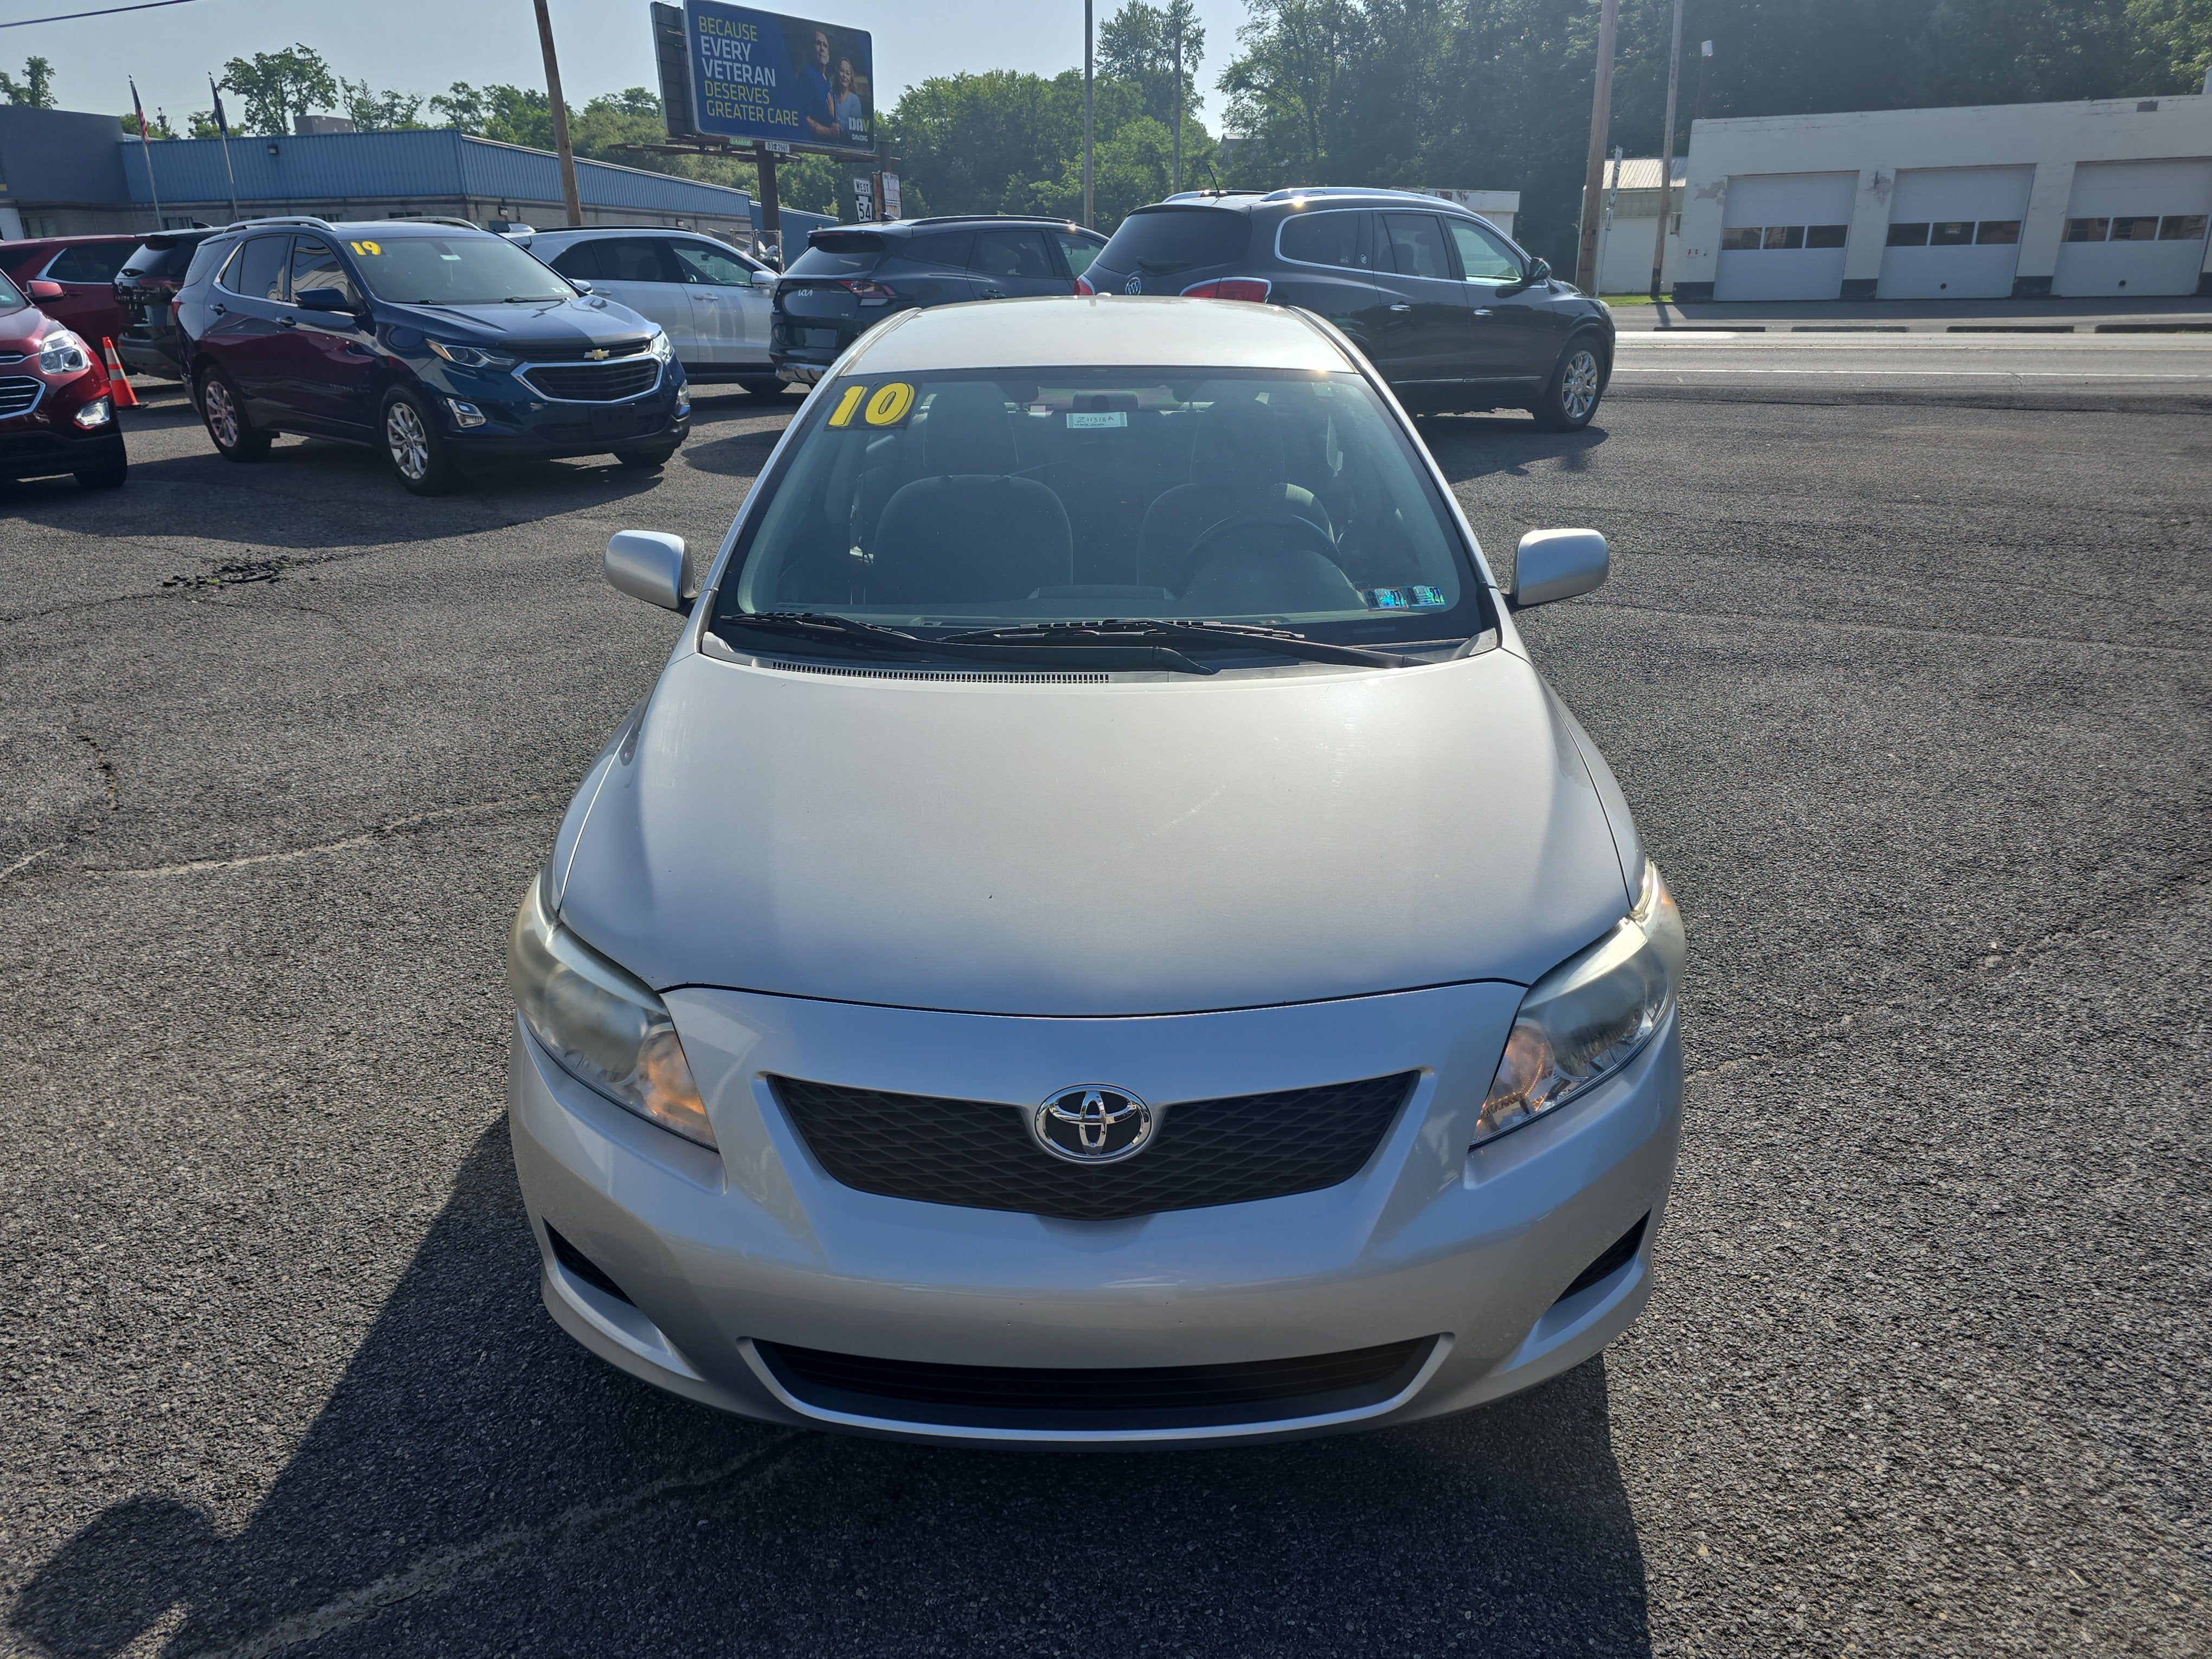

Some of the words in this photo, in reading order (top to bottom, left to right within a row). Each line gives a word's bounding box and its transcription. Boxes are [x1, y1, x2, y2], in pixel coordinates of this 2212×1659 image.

[698, 15, 758, 42] BECAUSE
[700, 35, 751, 62] EVERY
[702, 57, 776, 87] VETERAN
[705, 80, 770, 105] DESERVES
[706, 100, 765, 123] GREATER
[767, 107, 799, 126] CARE
[848, 117, 870, 132] DAV
[856, 181, 869, 192] WEST
[858, 203, 871, 220] 54
[350, 241, 381, 255] 19
[828, 382, 915, 428] 10
